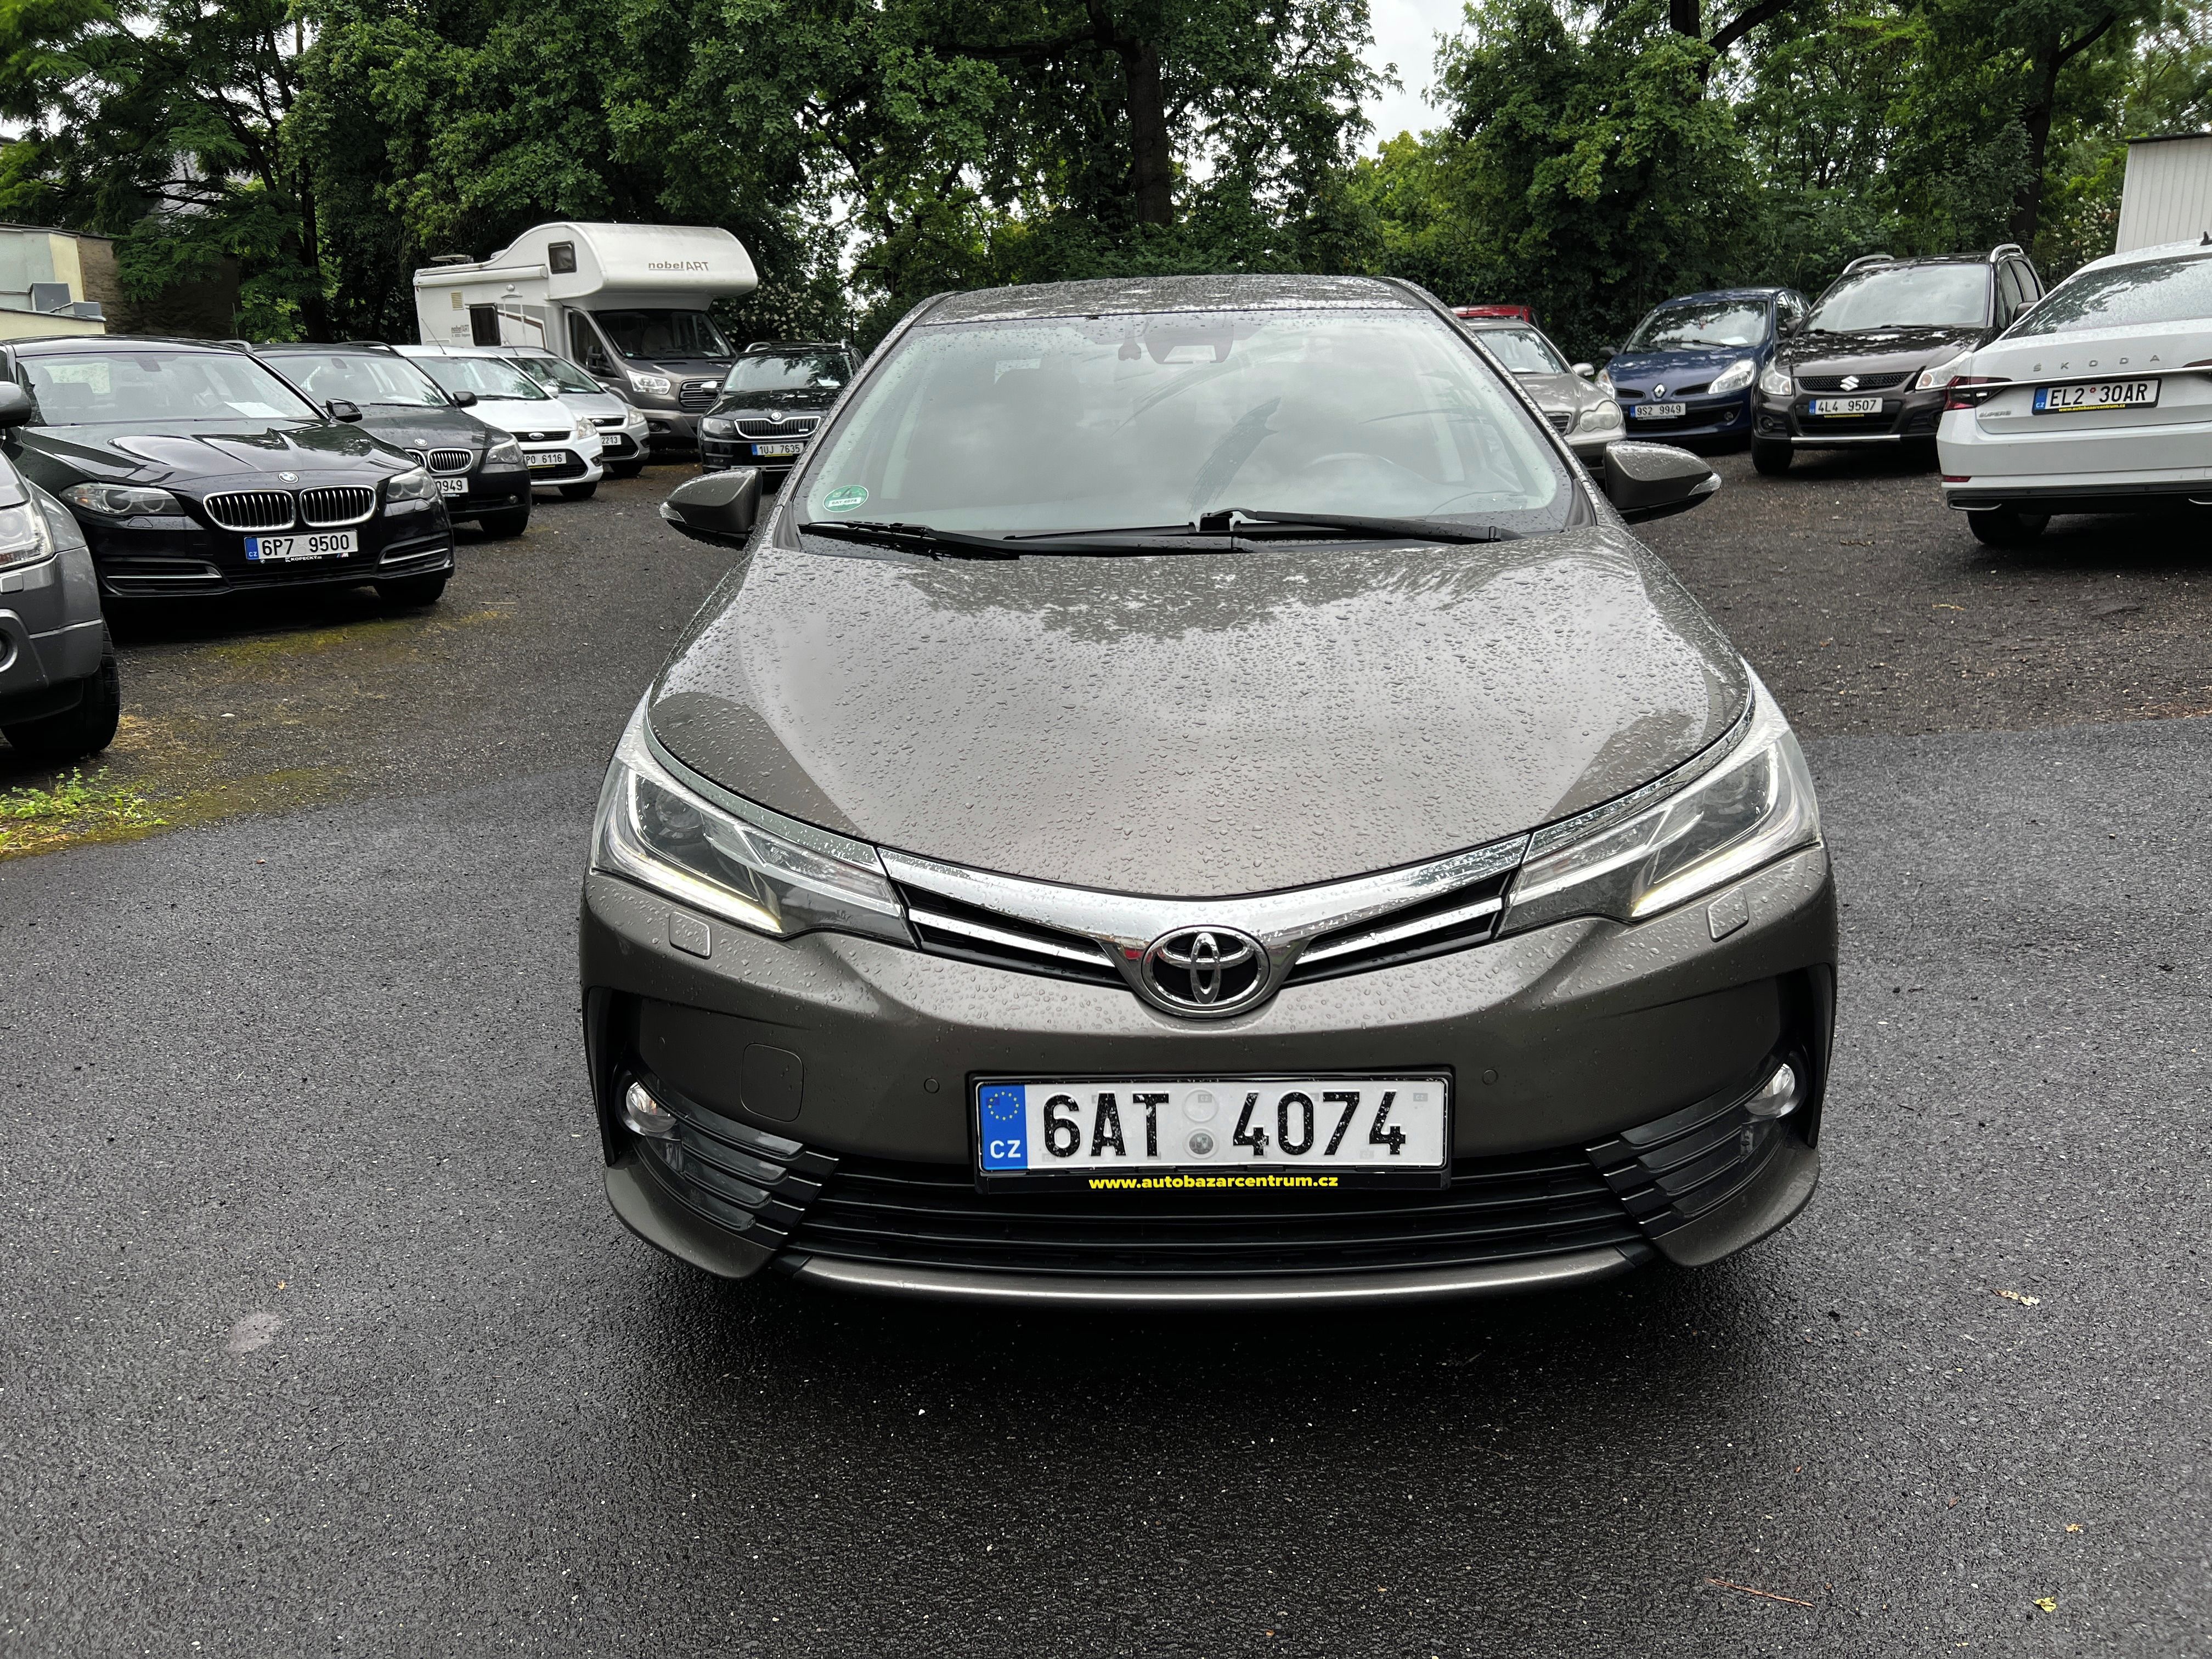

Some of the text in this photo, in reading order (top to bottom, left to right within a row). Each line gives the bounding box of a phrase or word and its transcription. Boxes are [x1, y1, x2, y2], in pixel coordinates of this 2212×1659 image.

[648, 261, 709, 271] nobelART
[2050, 383, 2148, 407] EL2 30AR
[1637, 407, 1652, 416] 9S2
[1660, 405, 1681, 414] 9949
[1818, 399, 1876, 412] 4L4 9507
[759, 445, 774, 454] 1UJ
[780, 444, 800, 453] 7635
[523, 454, 562, 464] P0 6116
[262, 534, 349, 556] 6P7 9500
[1042, 1090, 1406, 1158] 6AT 4074
[990, 1139, 1021, 1159] CZ
[1088, 1174, 1339, 1189] www.autobazarcentrum.cz
